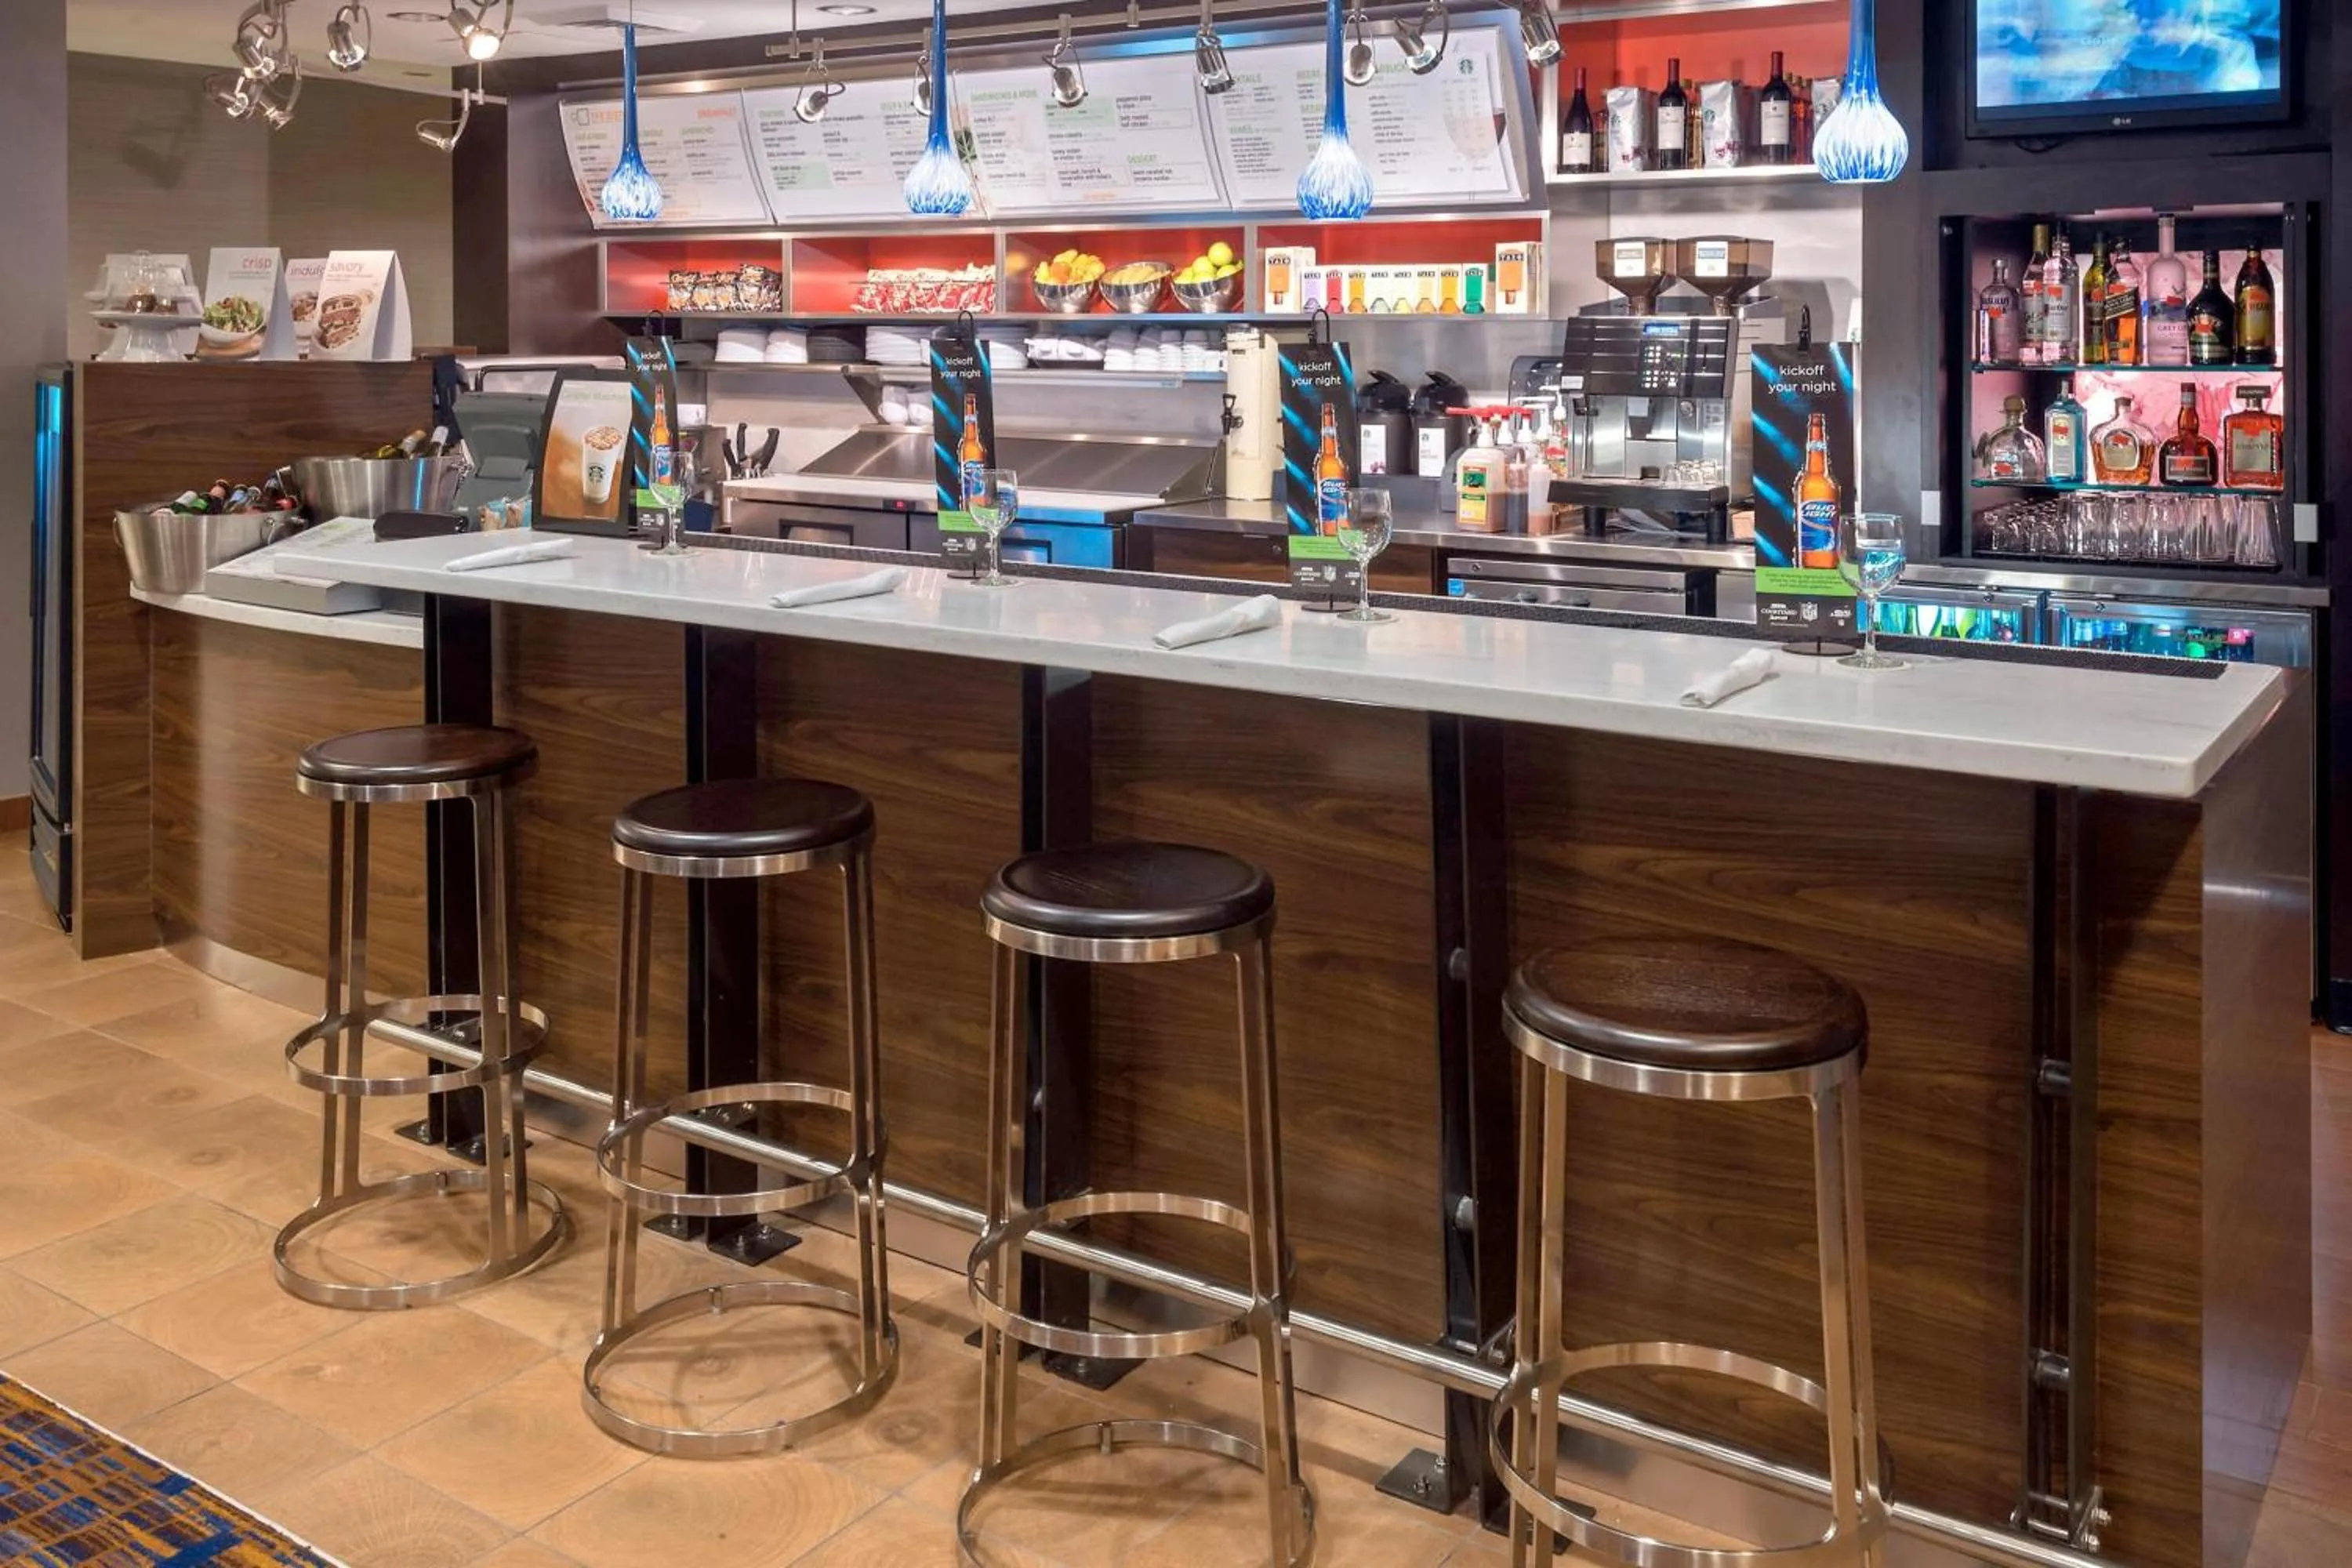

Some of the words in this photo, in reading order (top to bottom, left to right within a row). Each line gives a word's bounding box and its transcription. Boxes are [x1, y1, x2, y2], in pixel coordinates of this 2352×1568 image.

[242, 256, 272, 269] crisp
[328, 262, 365, 273] savory
[945, 355, 974, 366] kickoff
[1298, 361, 1332, 372] kickoff
[1778, 365, 1824, 376] kickoff
[940, 370, 958, 379] your
[959, 368, 982, 379] night
[1291, 377, 1313, 388] your
[1315, 376, 1341, 387] night
[1768, 383, 1799, 394] your
[1802, 380, 1837, 394] night
